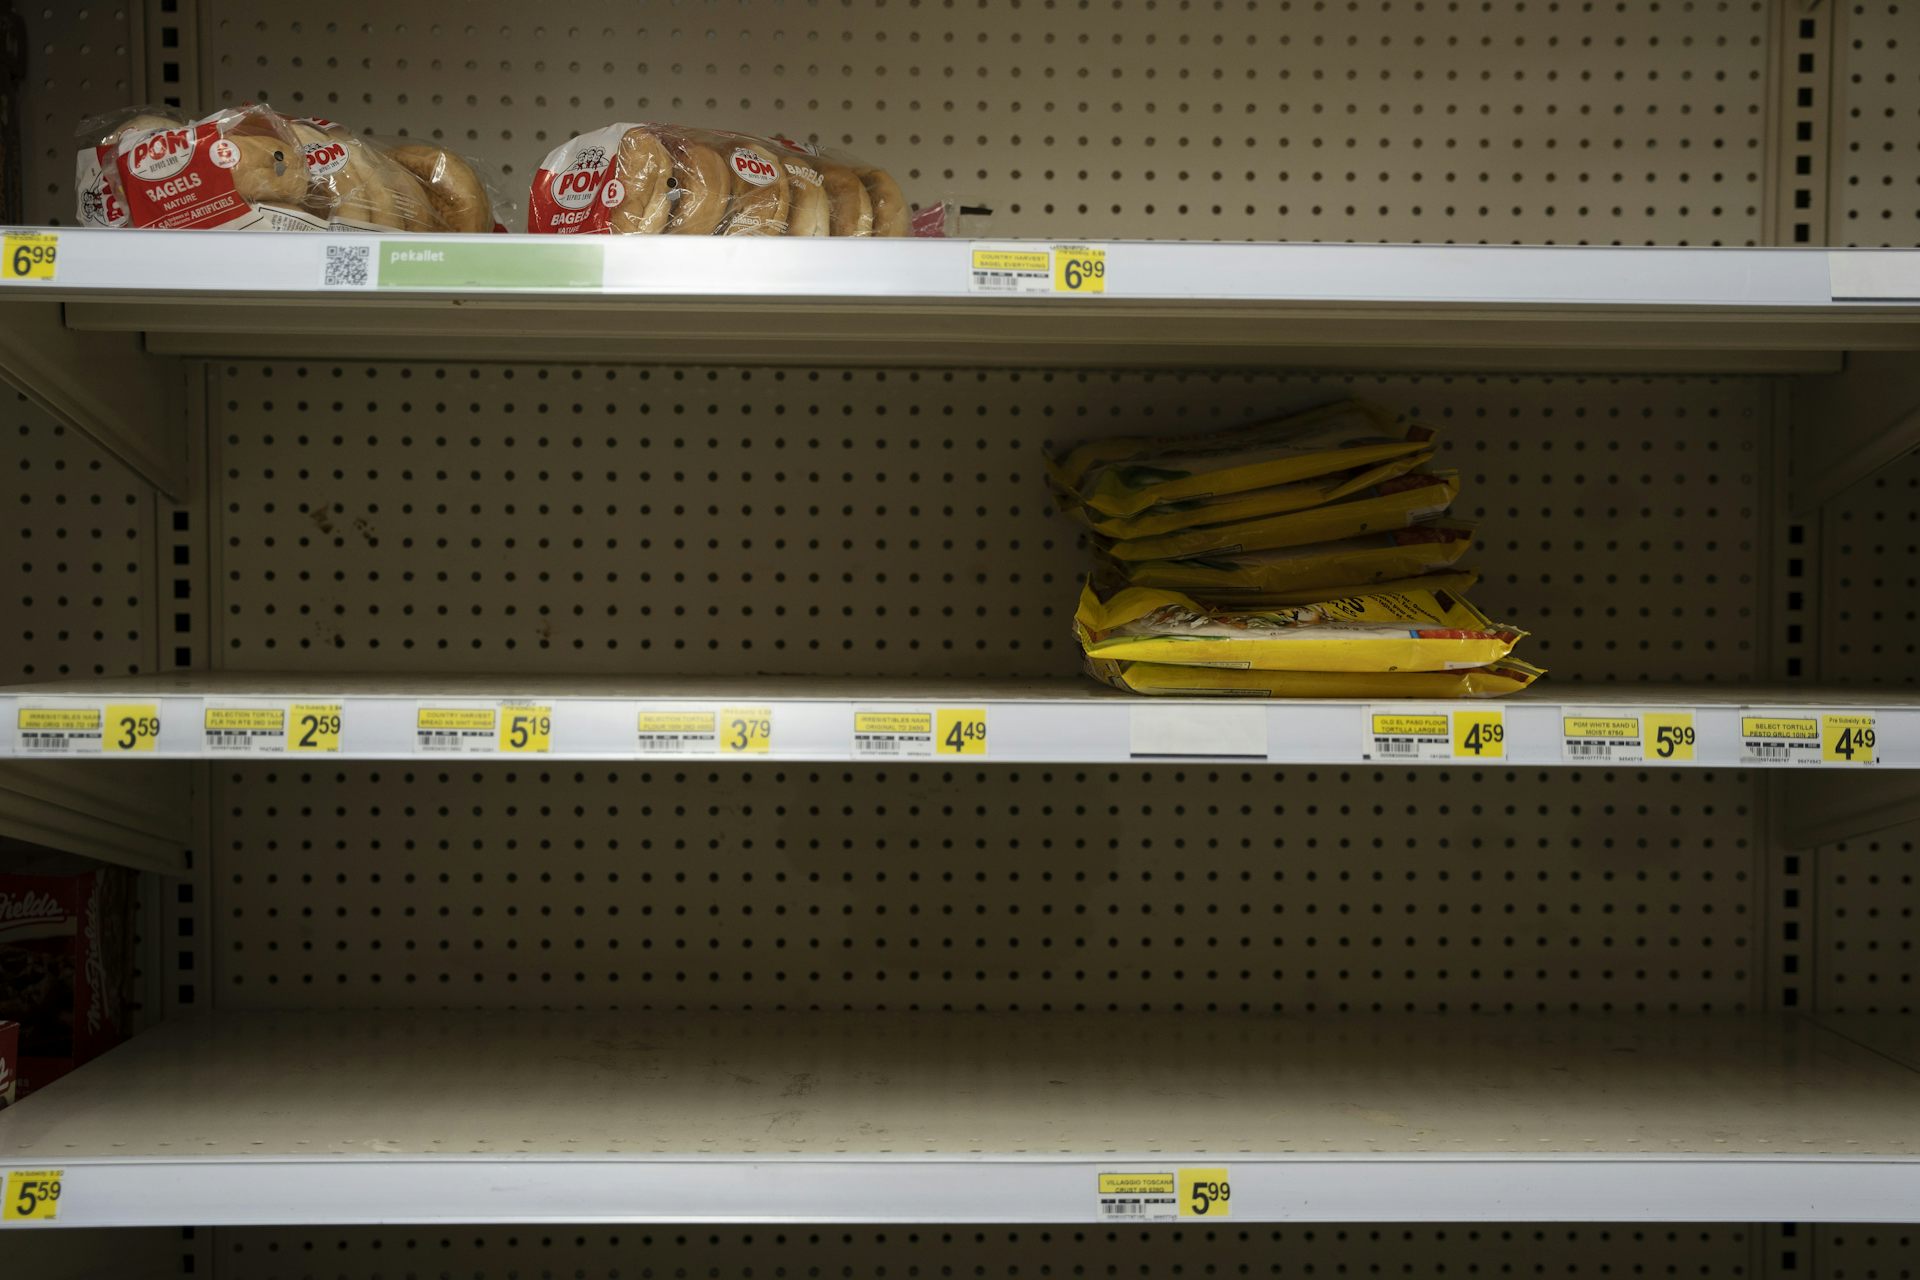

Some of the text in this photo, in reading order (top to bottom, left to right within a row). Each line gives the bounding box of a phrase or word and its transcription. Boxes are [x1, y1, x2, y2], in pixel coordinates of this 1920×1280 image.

[134, 130, 189, 169] POM
[735, 156, 776, 178] POM
[784, 163, 825, 188] BAGELS
[146, 172, 203, 203] BAGELS
[558, 168, 607, 196] POM
[607, 182, 618, 199] 6
[163, 193, 198, 211] NATURE
[190, 196, 235, 220] ARTIFICIELS
[550, 207, 592, 227] BAGELS
[390, 249, 444, 264] pekallet
[981, 253, 1045, 262] COUNTRY HARVEST
[1405, 719, 1423, 727] PASO
[1839, 717, 1859, 726] Subsidy
